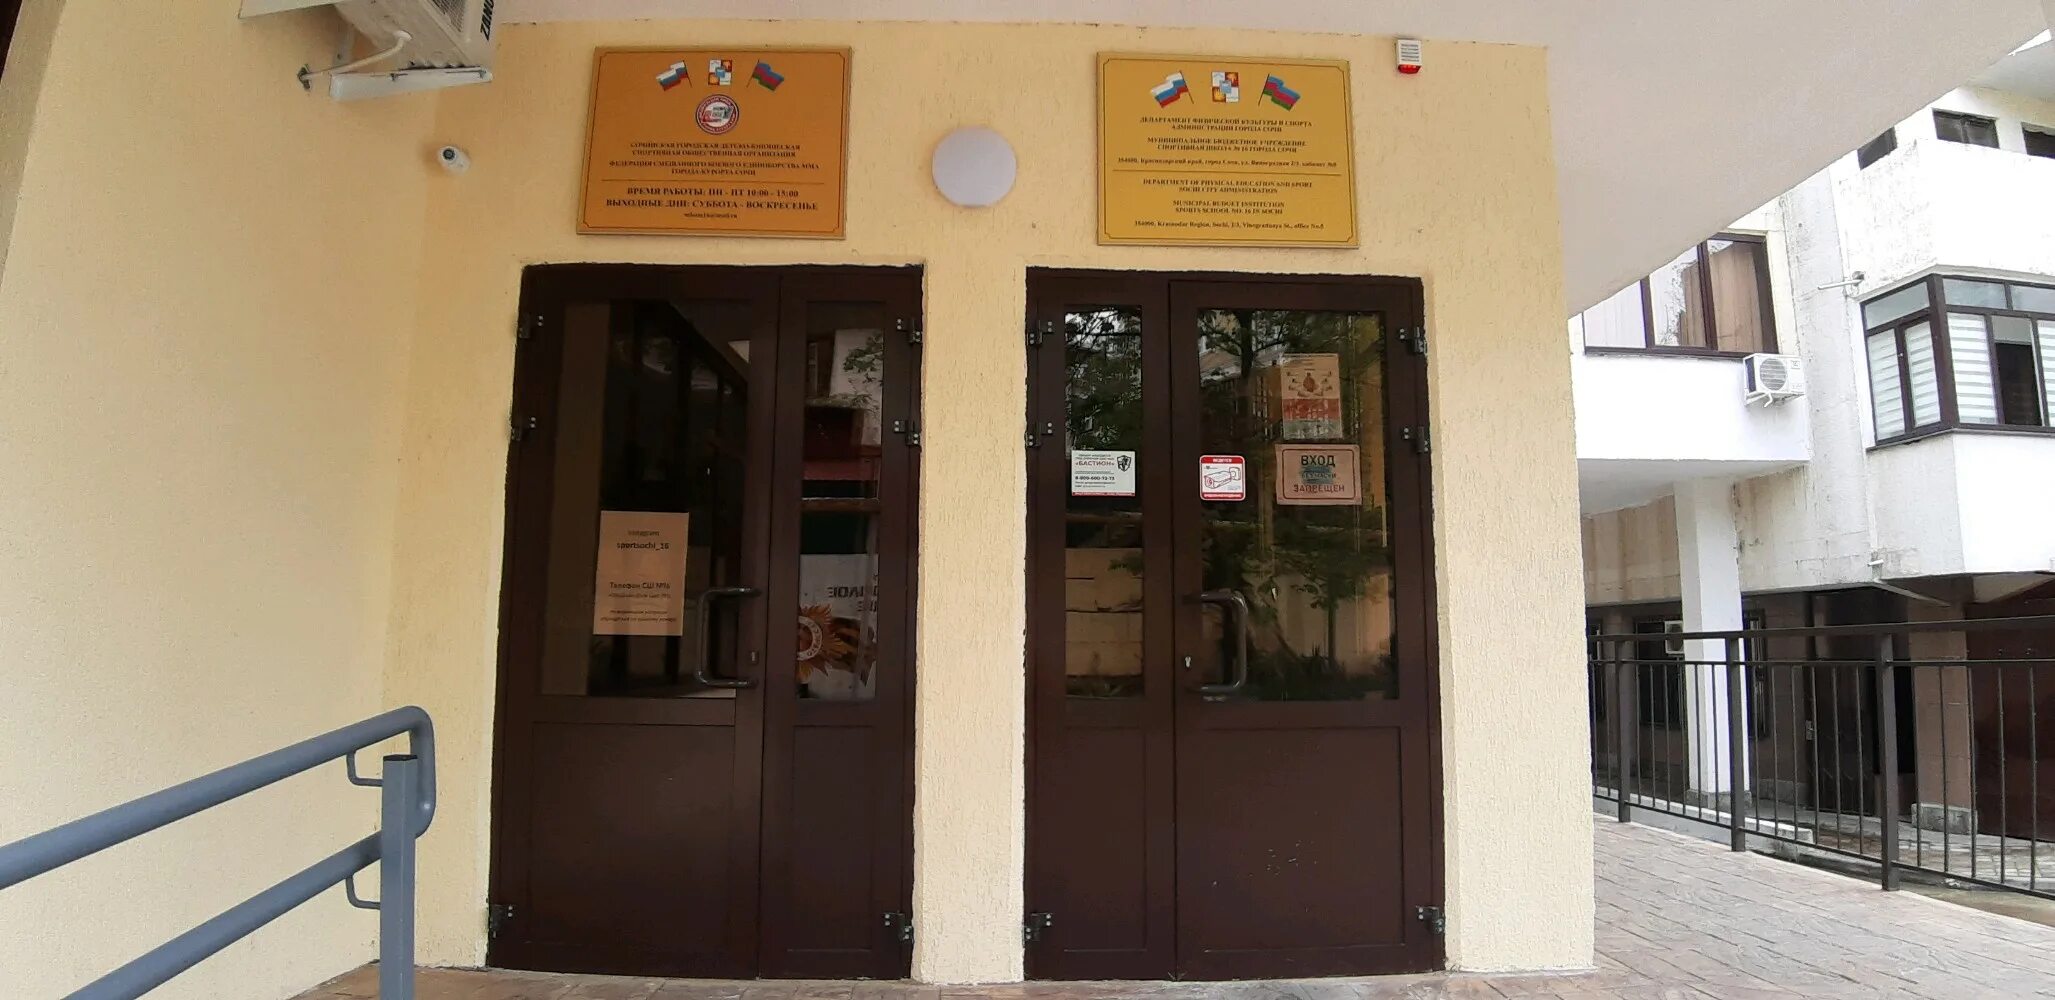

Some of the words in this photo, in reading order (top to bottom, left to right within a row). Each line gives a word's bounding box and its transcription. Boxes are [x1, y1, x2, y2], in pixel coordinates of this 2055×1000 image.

[627, 187, 661, 195] ВРЕМЯ
[663, 188, 706, 196] РАБОТЫ:
[708, 188, 723, 196] ПН
[731, 188, 745, 196] ПТ
[747, 189, 769, 197] 10:00
[606, 199, 662, 207] ВЫХОДНЫЕ
[665, 200, 690, 208] ДНИ:
[692, 200, 738, 209] СУББОТА
[746, 201, 818, 210] ВОСКРЕСЕНЬЕ
[1301, 455, 1336, 467] ВХОД
[1293, 484, 1345, 493] ЗАПРЕЩЕН
[609, 581, 641, 590] Телефон
[642, 582, 655, 590] СШ
